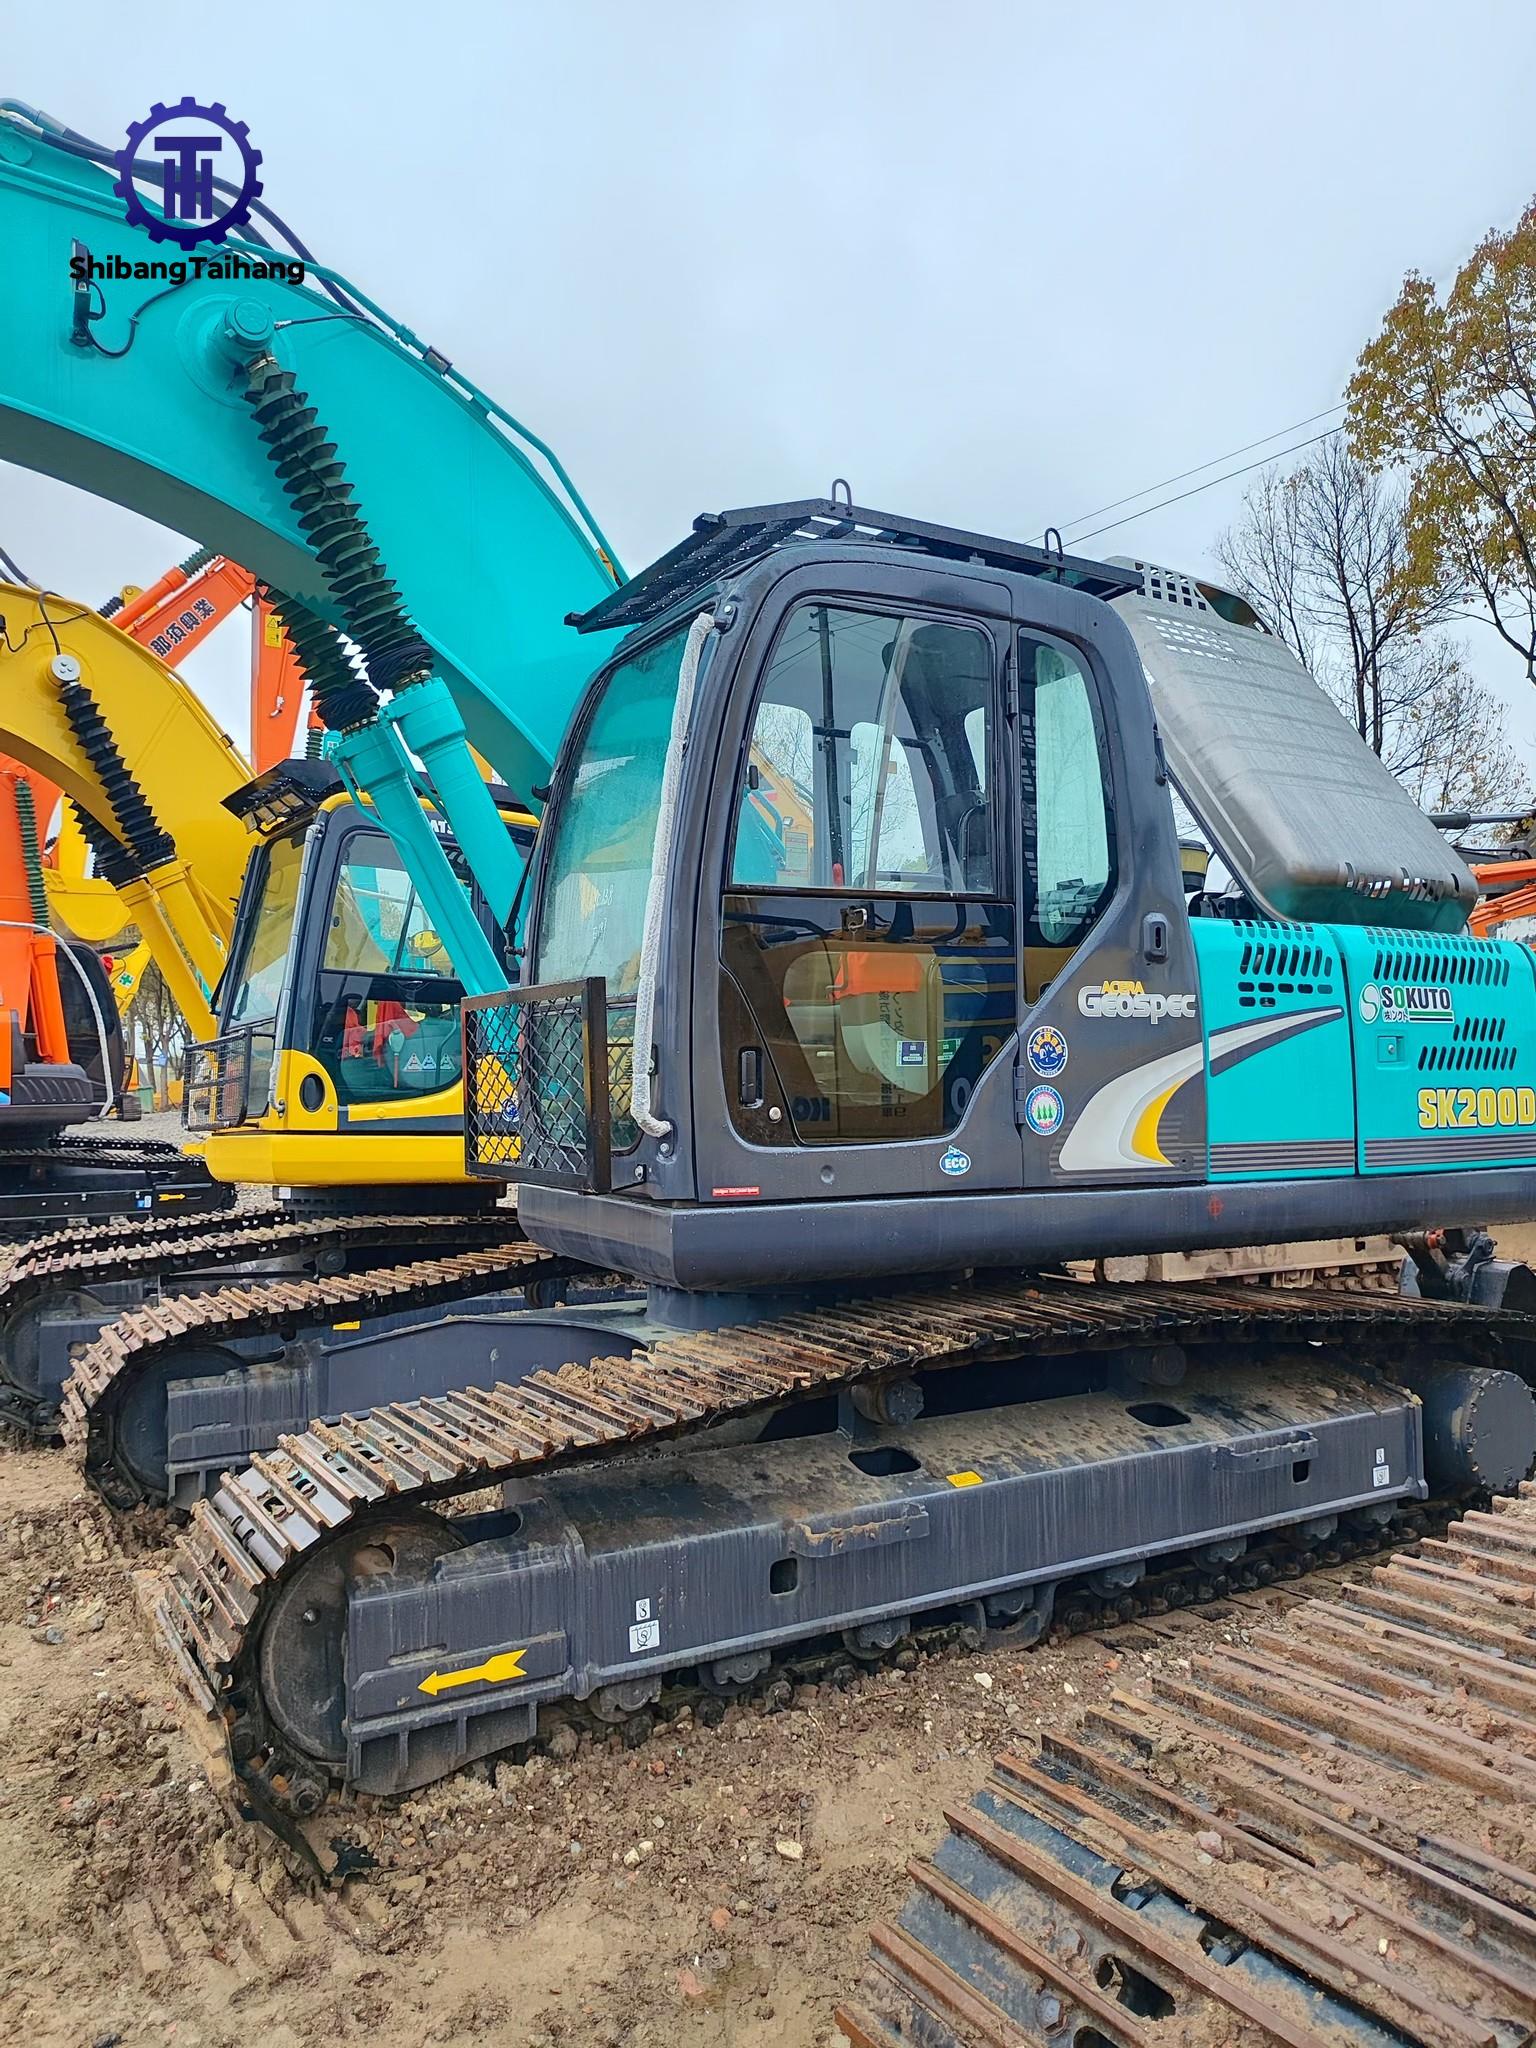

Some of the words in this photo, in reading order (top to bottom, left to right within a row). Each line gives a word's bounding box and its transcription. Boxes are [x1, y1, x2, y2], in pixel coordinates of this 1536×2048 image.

[1101, 980, 1145, 994] ACERA
[1381, 986, 1451, 1010] SOKUTO
[1417, 1087, 1536, 1130] SK200D
[944, 1157, 968, 1169] ECO
